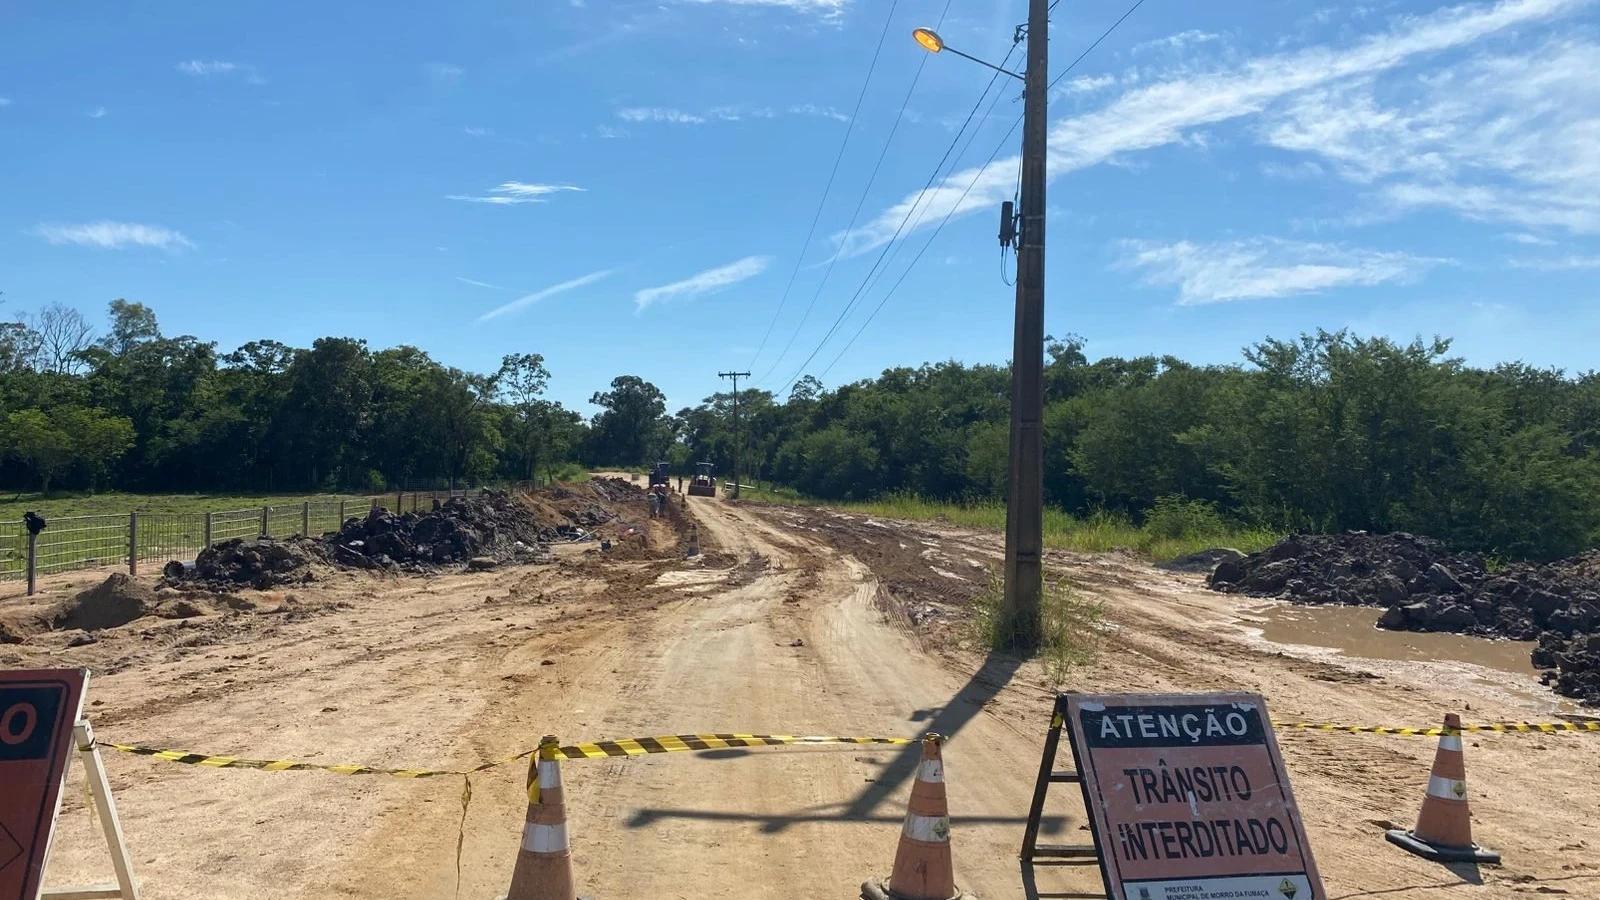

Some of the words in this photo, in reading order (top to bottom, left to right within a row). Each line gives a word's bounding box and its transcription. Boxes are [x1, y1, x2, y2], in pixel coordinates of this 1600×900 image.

[1100, 708, 1248, 743] ATENÇÃO
[1123, 758, 1251, 804] TRÂNSITO
[1117, 817, 1288, 861] INTERDITADO
[1164, 885, 1204, 893] PREFEITURA
[1166, 892, 1200, 900] MUNICIPAL
